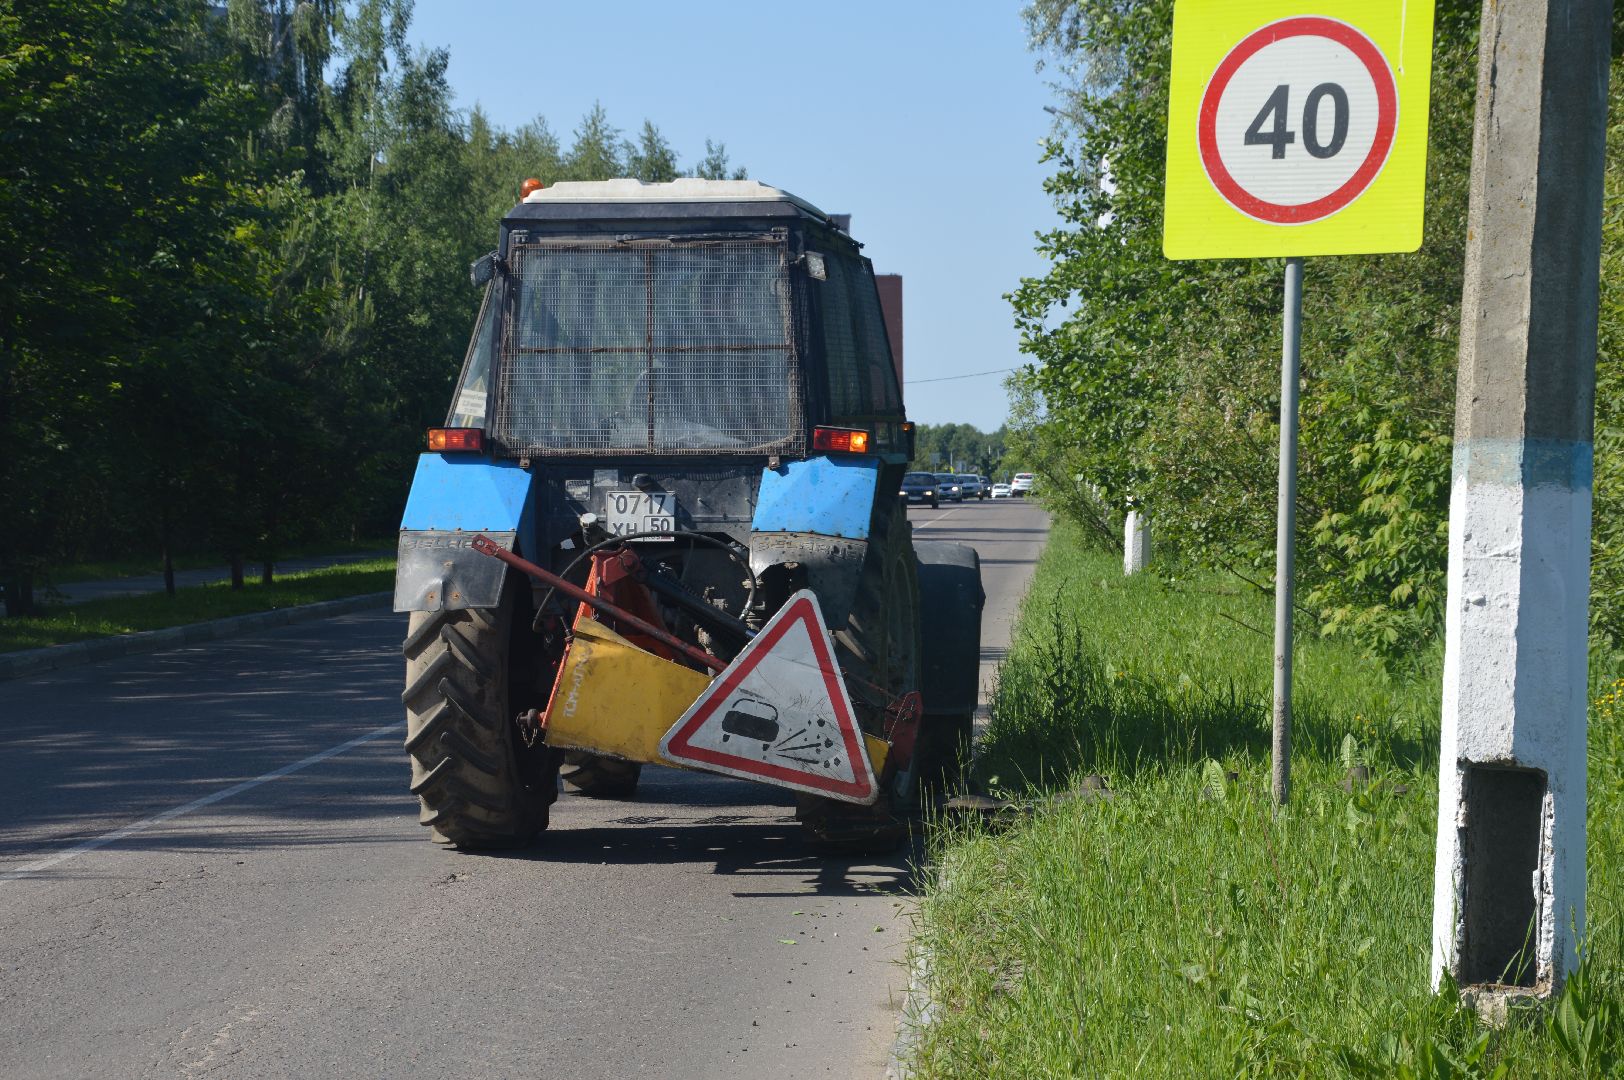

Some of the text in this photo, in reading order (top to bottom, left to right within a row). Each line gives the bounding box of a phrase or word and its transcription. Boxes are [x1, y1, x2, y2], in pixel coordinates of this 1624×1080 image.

[1244, 82, 1350, 160] 40
[615, 494, 667, 515] 0717
[650, 518, 670, 532] 50
